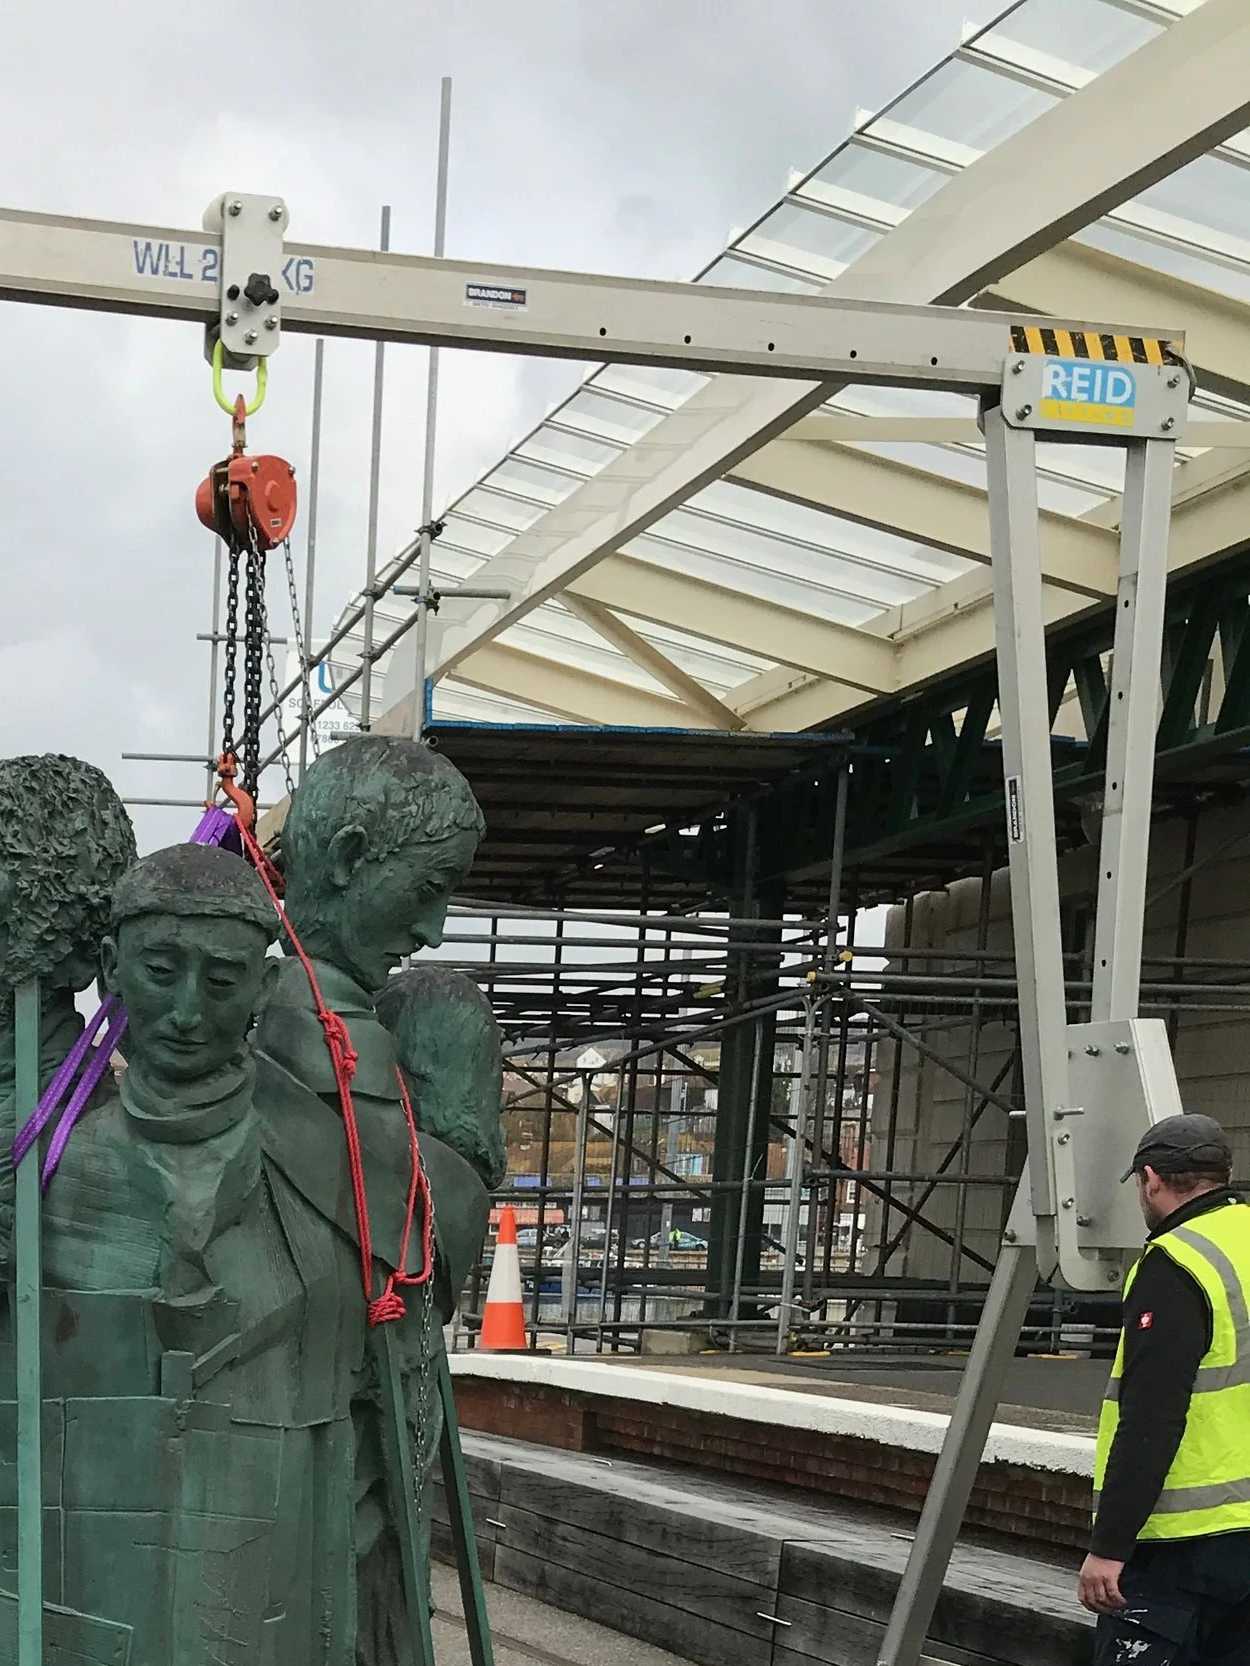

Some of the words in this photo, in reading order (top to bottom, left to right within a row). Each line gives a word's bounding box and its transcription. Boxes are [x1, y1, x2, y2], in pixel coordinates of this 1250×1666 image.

[132, 239, 194, 280] WLL
[200, 248, 219, 283] 2
[468, 287, 512, 300] BRANDON
[1042, 364, 1132, 405] REID
[1011, 794, 1019, 838] BRANDON
